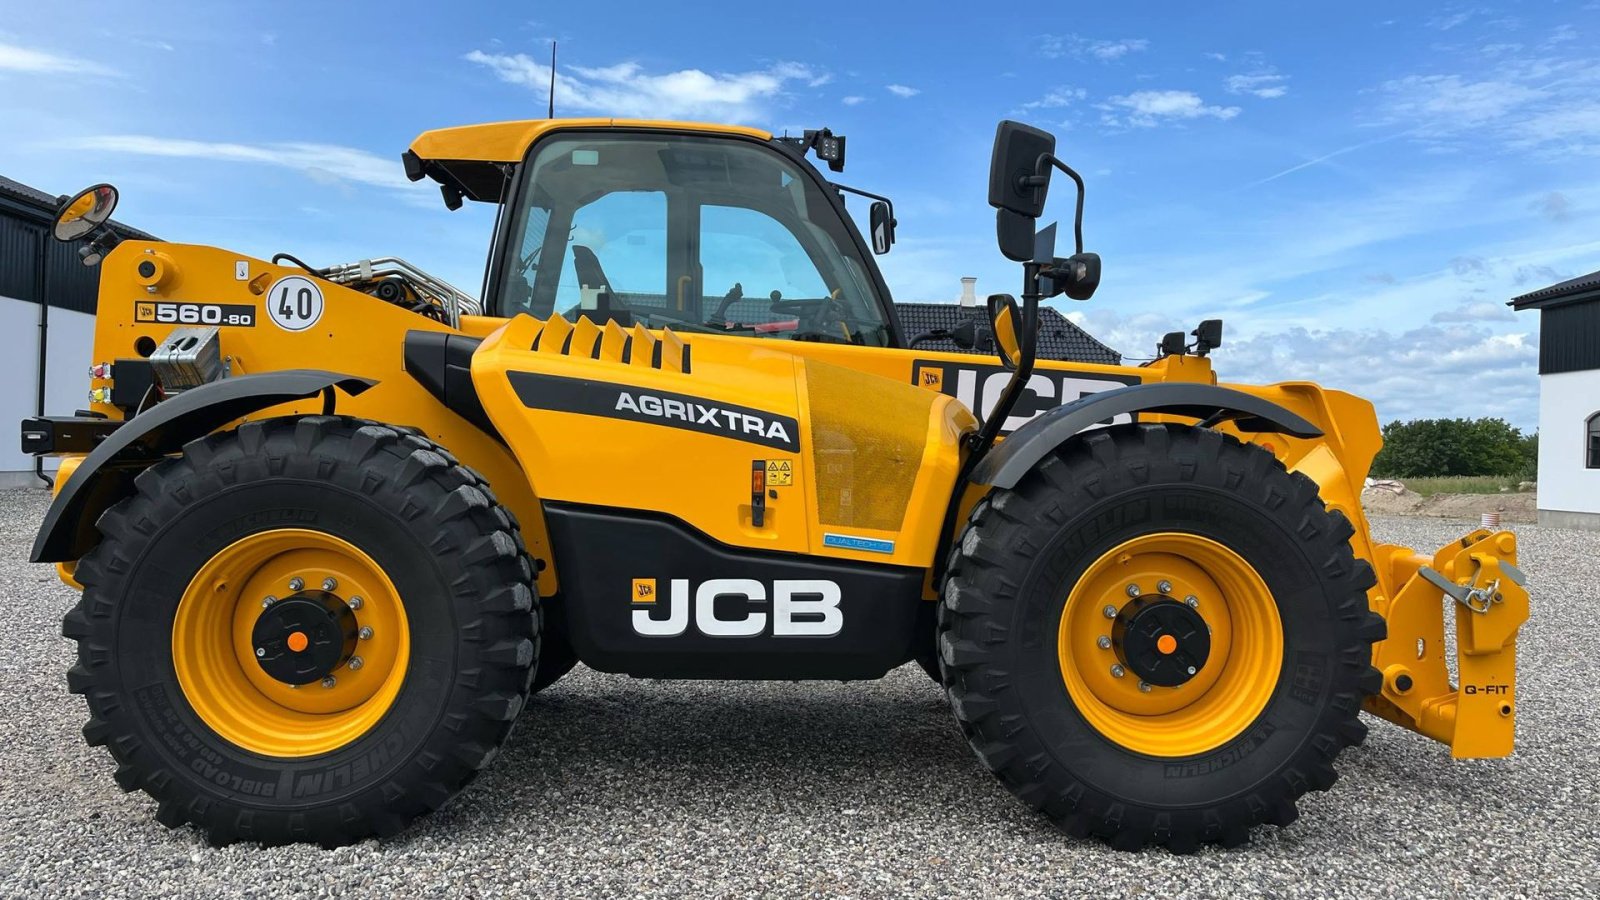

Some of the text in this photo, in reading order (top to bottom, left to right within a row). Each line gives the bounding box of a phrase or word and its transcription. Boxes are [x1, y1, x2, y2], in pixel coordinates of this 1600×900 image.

[157, 304, 251, 325] 560-80
[278, 287, 312, 320] 40
[922, 371, 940, 386] JCB
[615, 392, 791, 443] AGRIXTRA
[636, 583, 653, 597] JCB
[632, 579, 843, 636] JCB
[1465, 685, 1509, 695] Q-FIT
[190, 757, 275, 796] BIBLOAD
